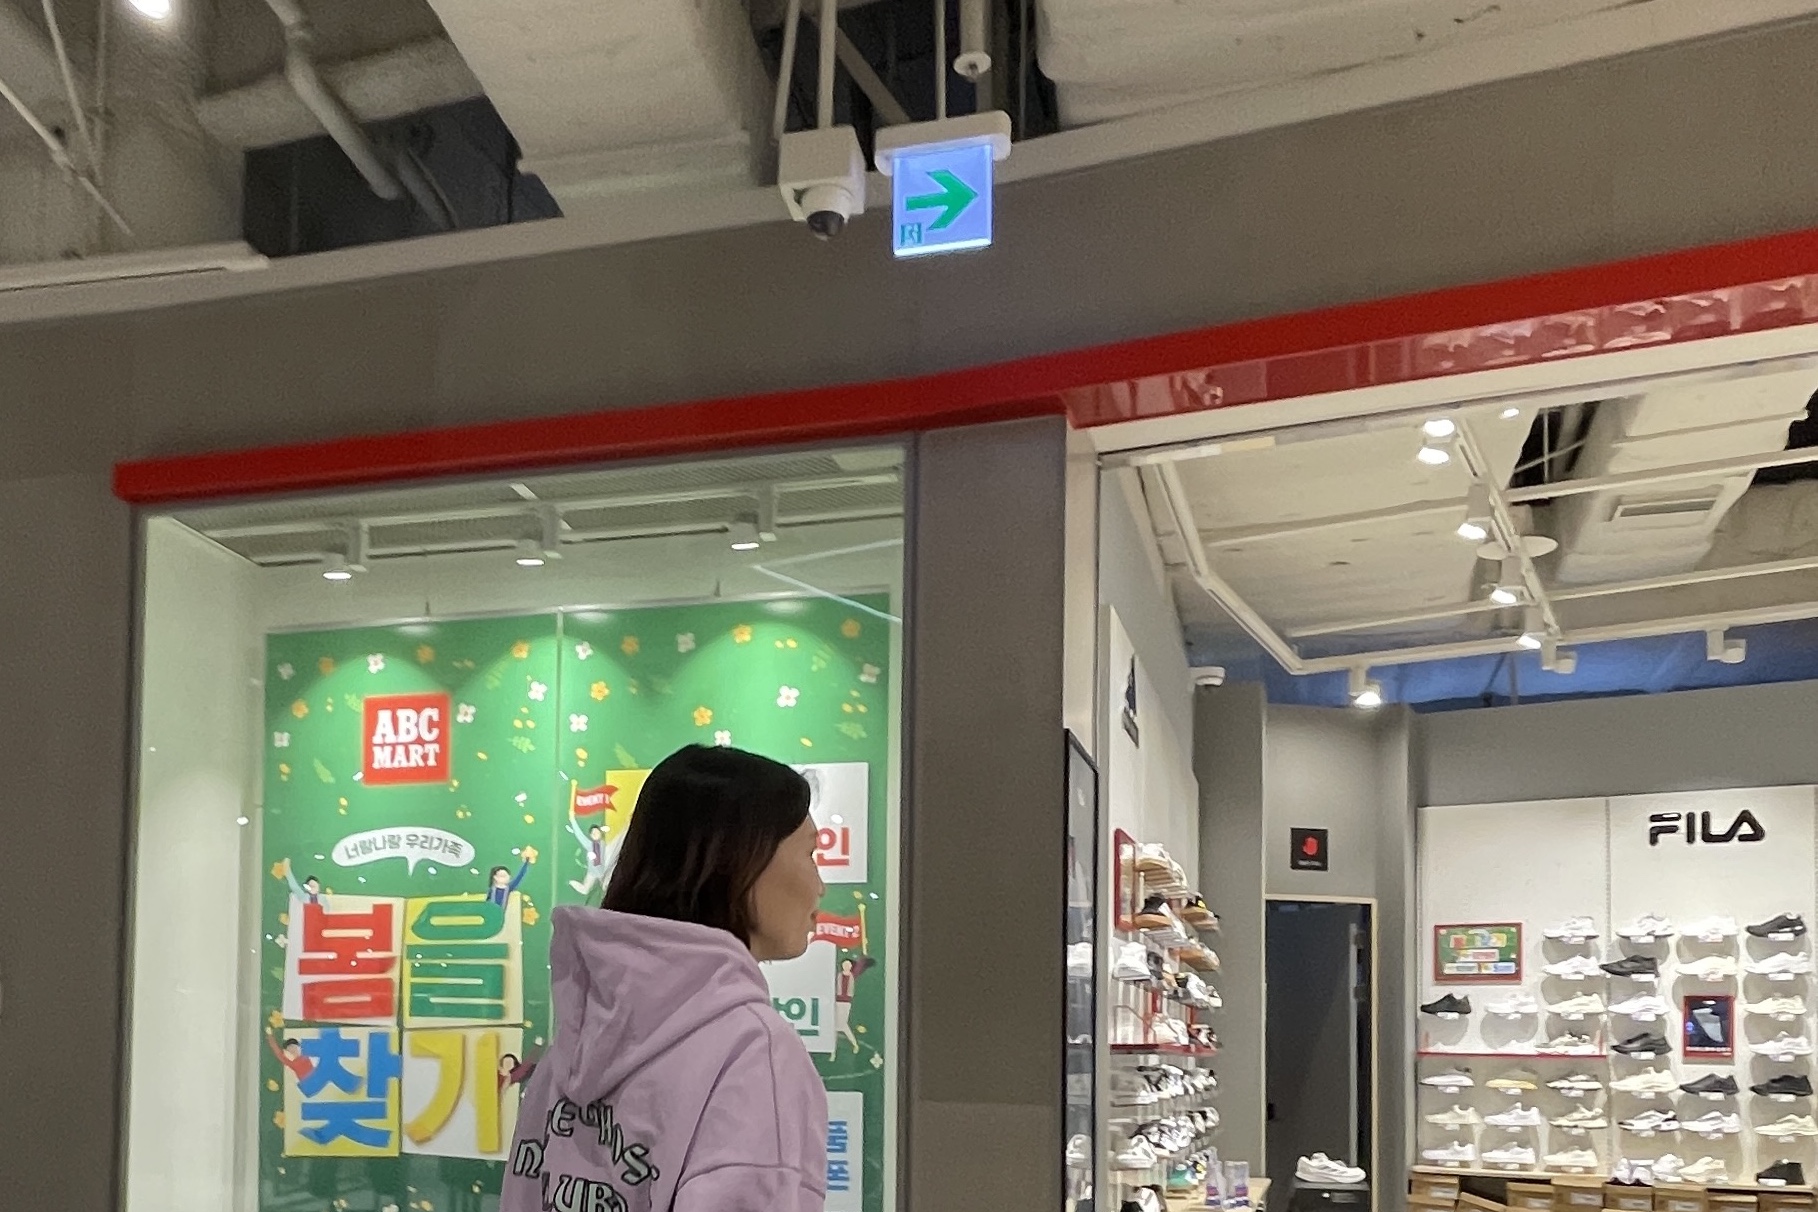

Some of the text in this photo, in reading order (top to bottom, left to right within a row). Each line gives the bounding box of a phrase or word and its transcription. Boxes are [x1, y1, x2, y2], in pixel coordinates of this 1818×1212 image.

[372, 707, 440, 744] ABC
[372, 743, 440, 769] MART
[816, 826, 850, 866] 인
[1649, 809, 1765, 846] FILA
[343, 834, 464, 859] 너랑나랑 우리가족
[298, 903, 509, 1021] 봄을
[773, 998, 819, 1036] 인
[297, 1028, 500, 1154] 찾기
